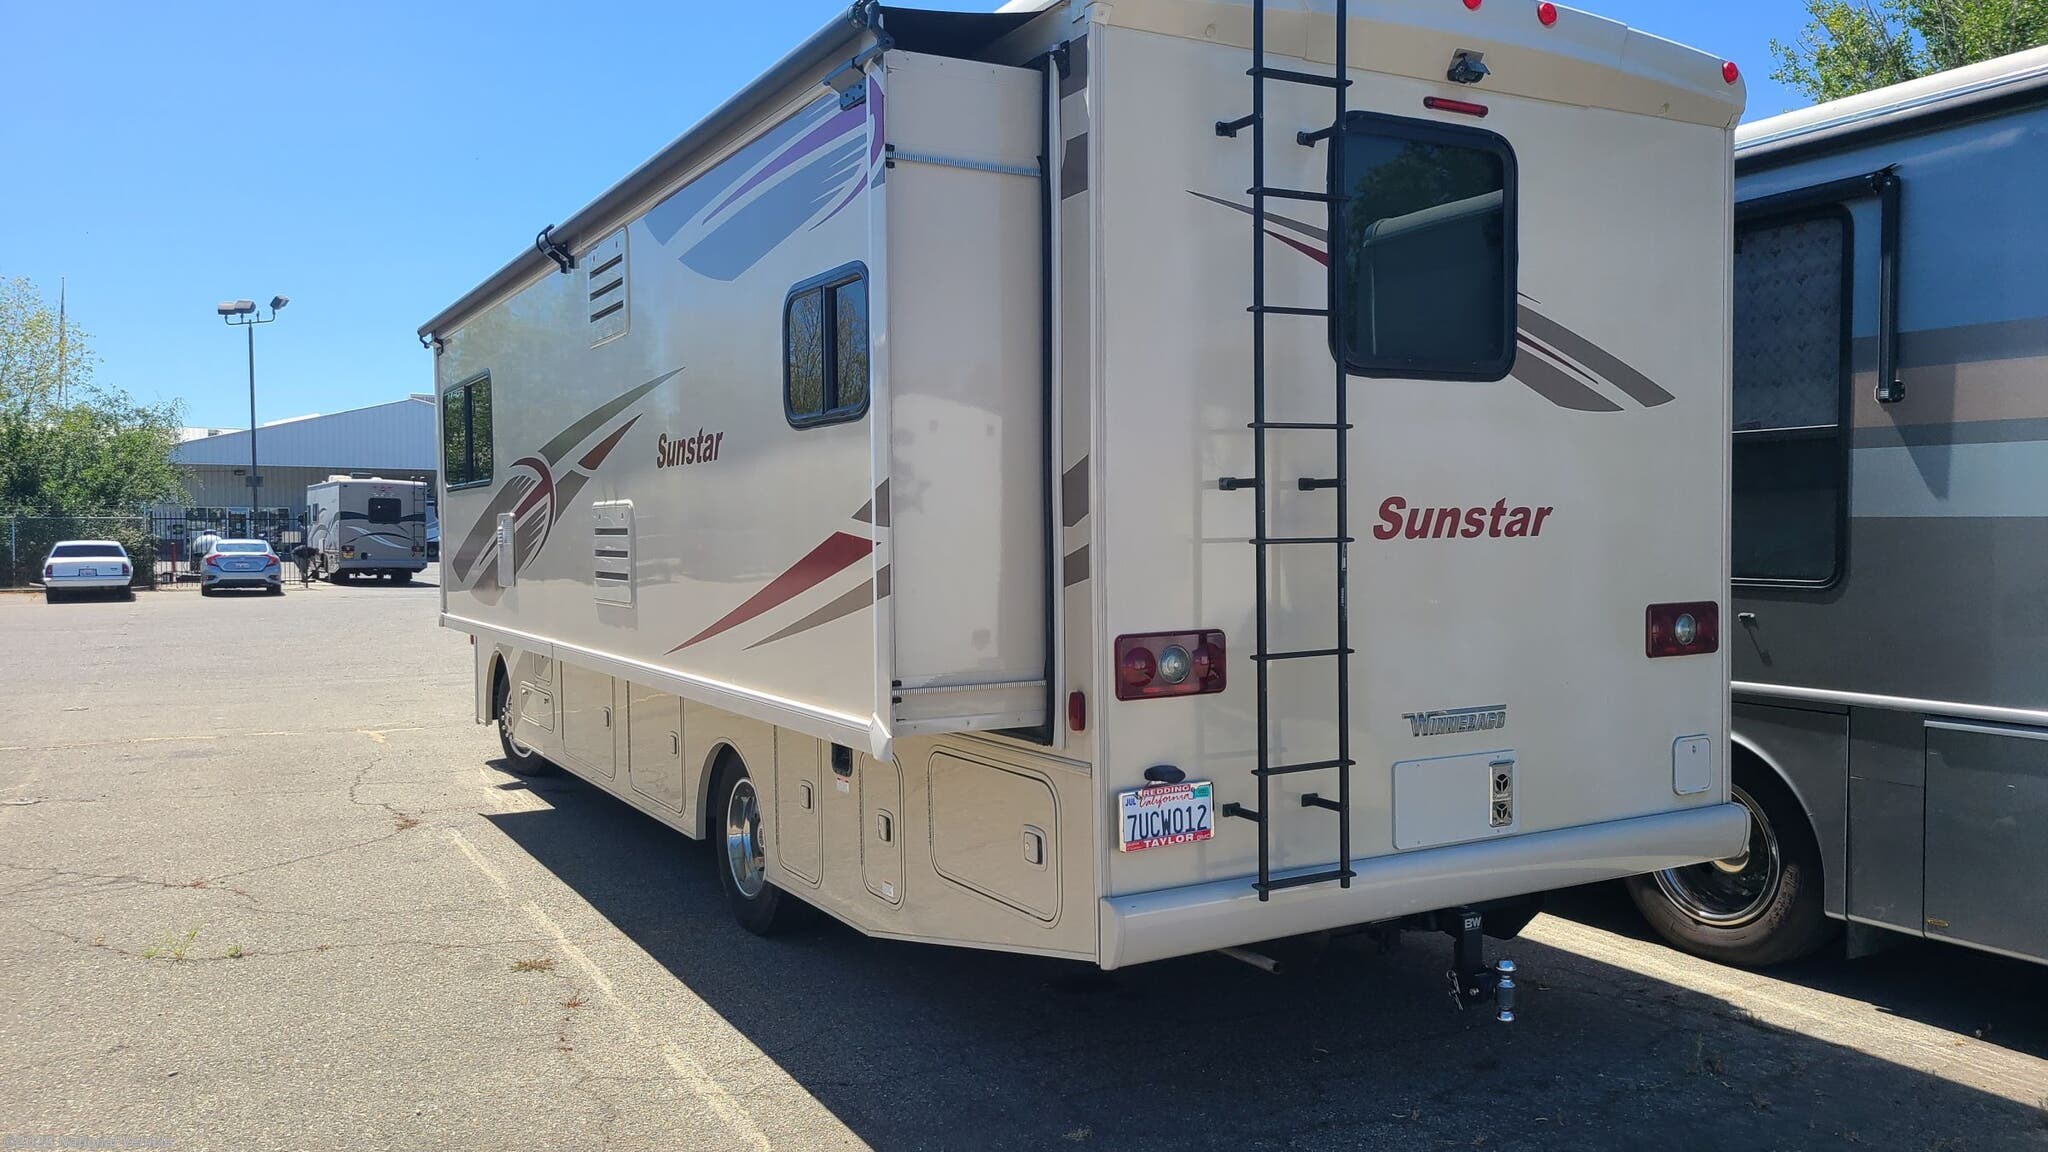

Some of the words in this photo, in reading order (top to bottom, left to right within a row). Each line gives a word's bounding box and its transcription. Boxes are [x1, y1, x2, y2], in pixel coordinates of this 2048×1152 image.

[657, 426, 723, 469] Sunstar
[1373, 496, 1554, 540] Sunstar
[1143, 785, 1190, 796] REDDING
[1125, 797, 1136, 807] JUL
[1140, 793, 1193, 808] California
[1127, 804, 1207, 841] 7UCW012
[1144, 833, 1194, 848] TAYLOR
[1464, 917, 1482, 929] BW
